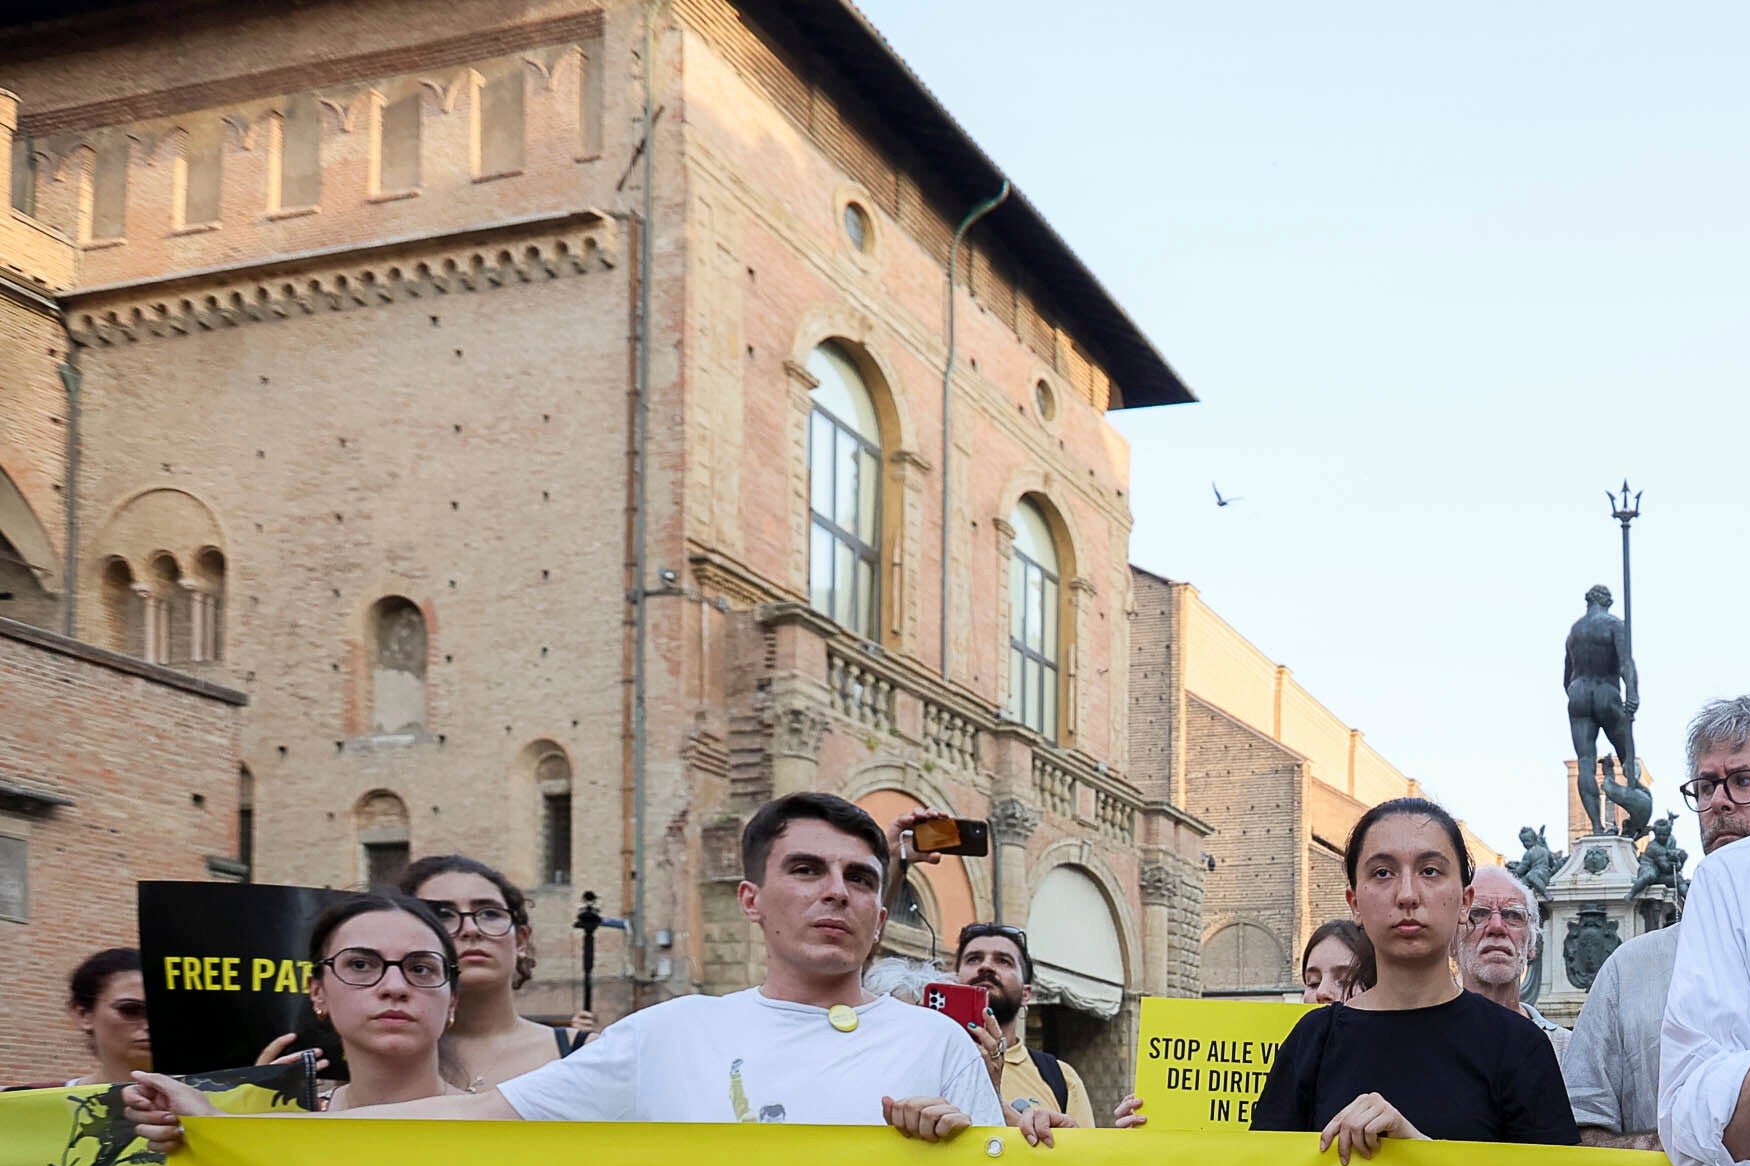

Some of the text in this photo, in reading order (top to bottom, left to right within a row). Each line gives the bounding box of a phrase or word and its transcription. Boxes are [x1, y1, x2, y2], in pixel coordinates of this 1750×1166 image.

[164, 956, 241, 991] FREE
[1149, 1037, 1200, 1061] STOP
[1207, 1040, 1253, 1063] ALLE
[1167, 1067, 1200, 1090] DEI
[1210, 1099, 1230, 1121] IN
